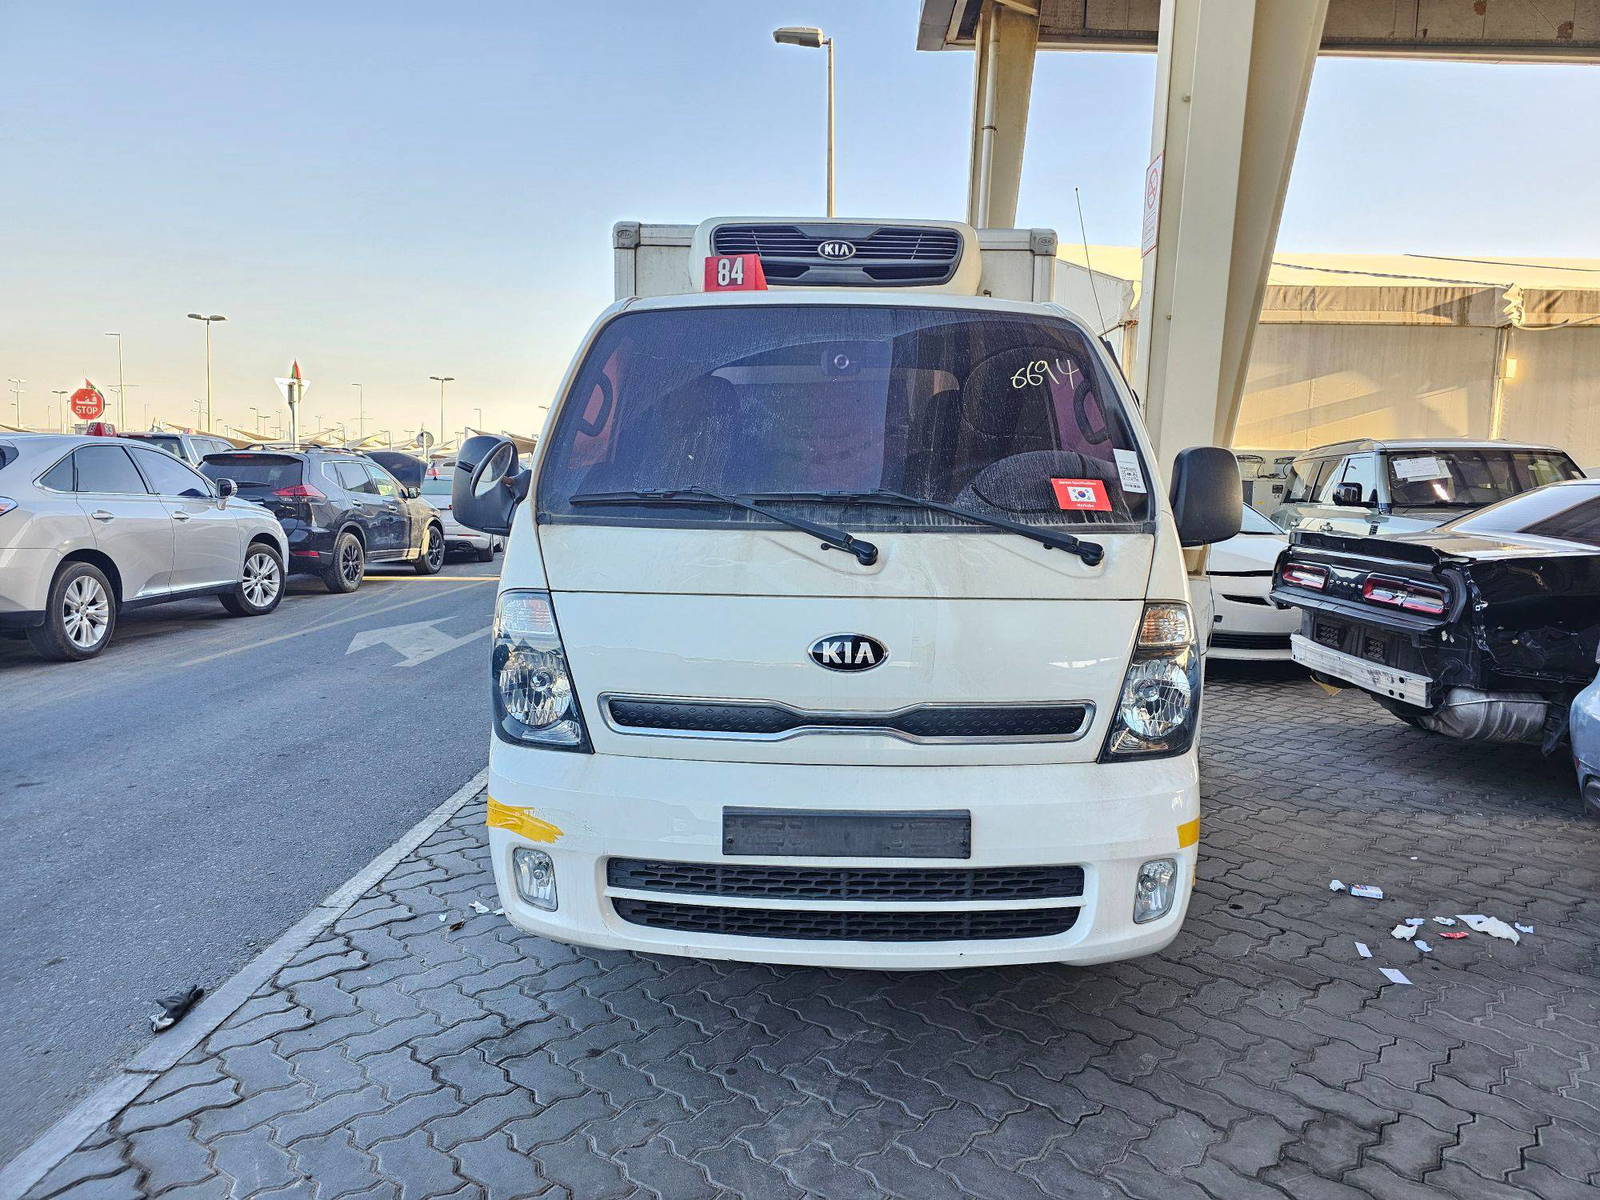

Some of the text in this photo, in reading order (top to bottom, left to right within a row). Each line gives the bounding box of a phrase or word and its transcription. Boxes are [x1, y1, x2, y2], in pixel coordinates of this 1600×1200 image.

[824, 244, 850, 256] KIA
[717, 256, 744, 286] 84
[1010, 359, 1080, 389] 6694
[76, 393, 97, 405] قف
[75, 406, 98, 415] STOP
[822, 641, 876, 664] KIA
